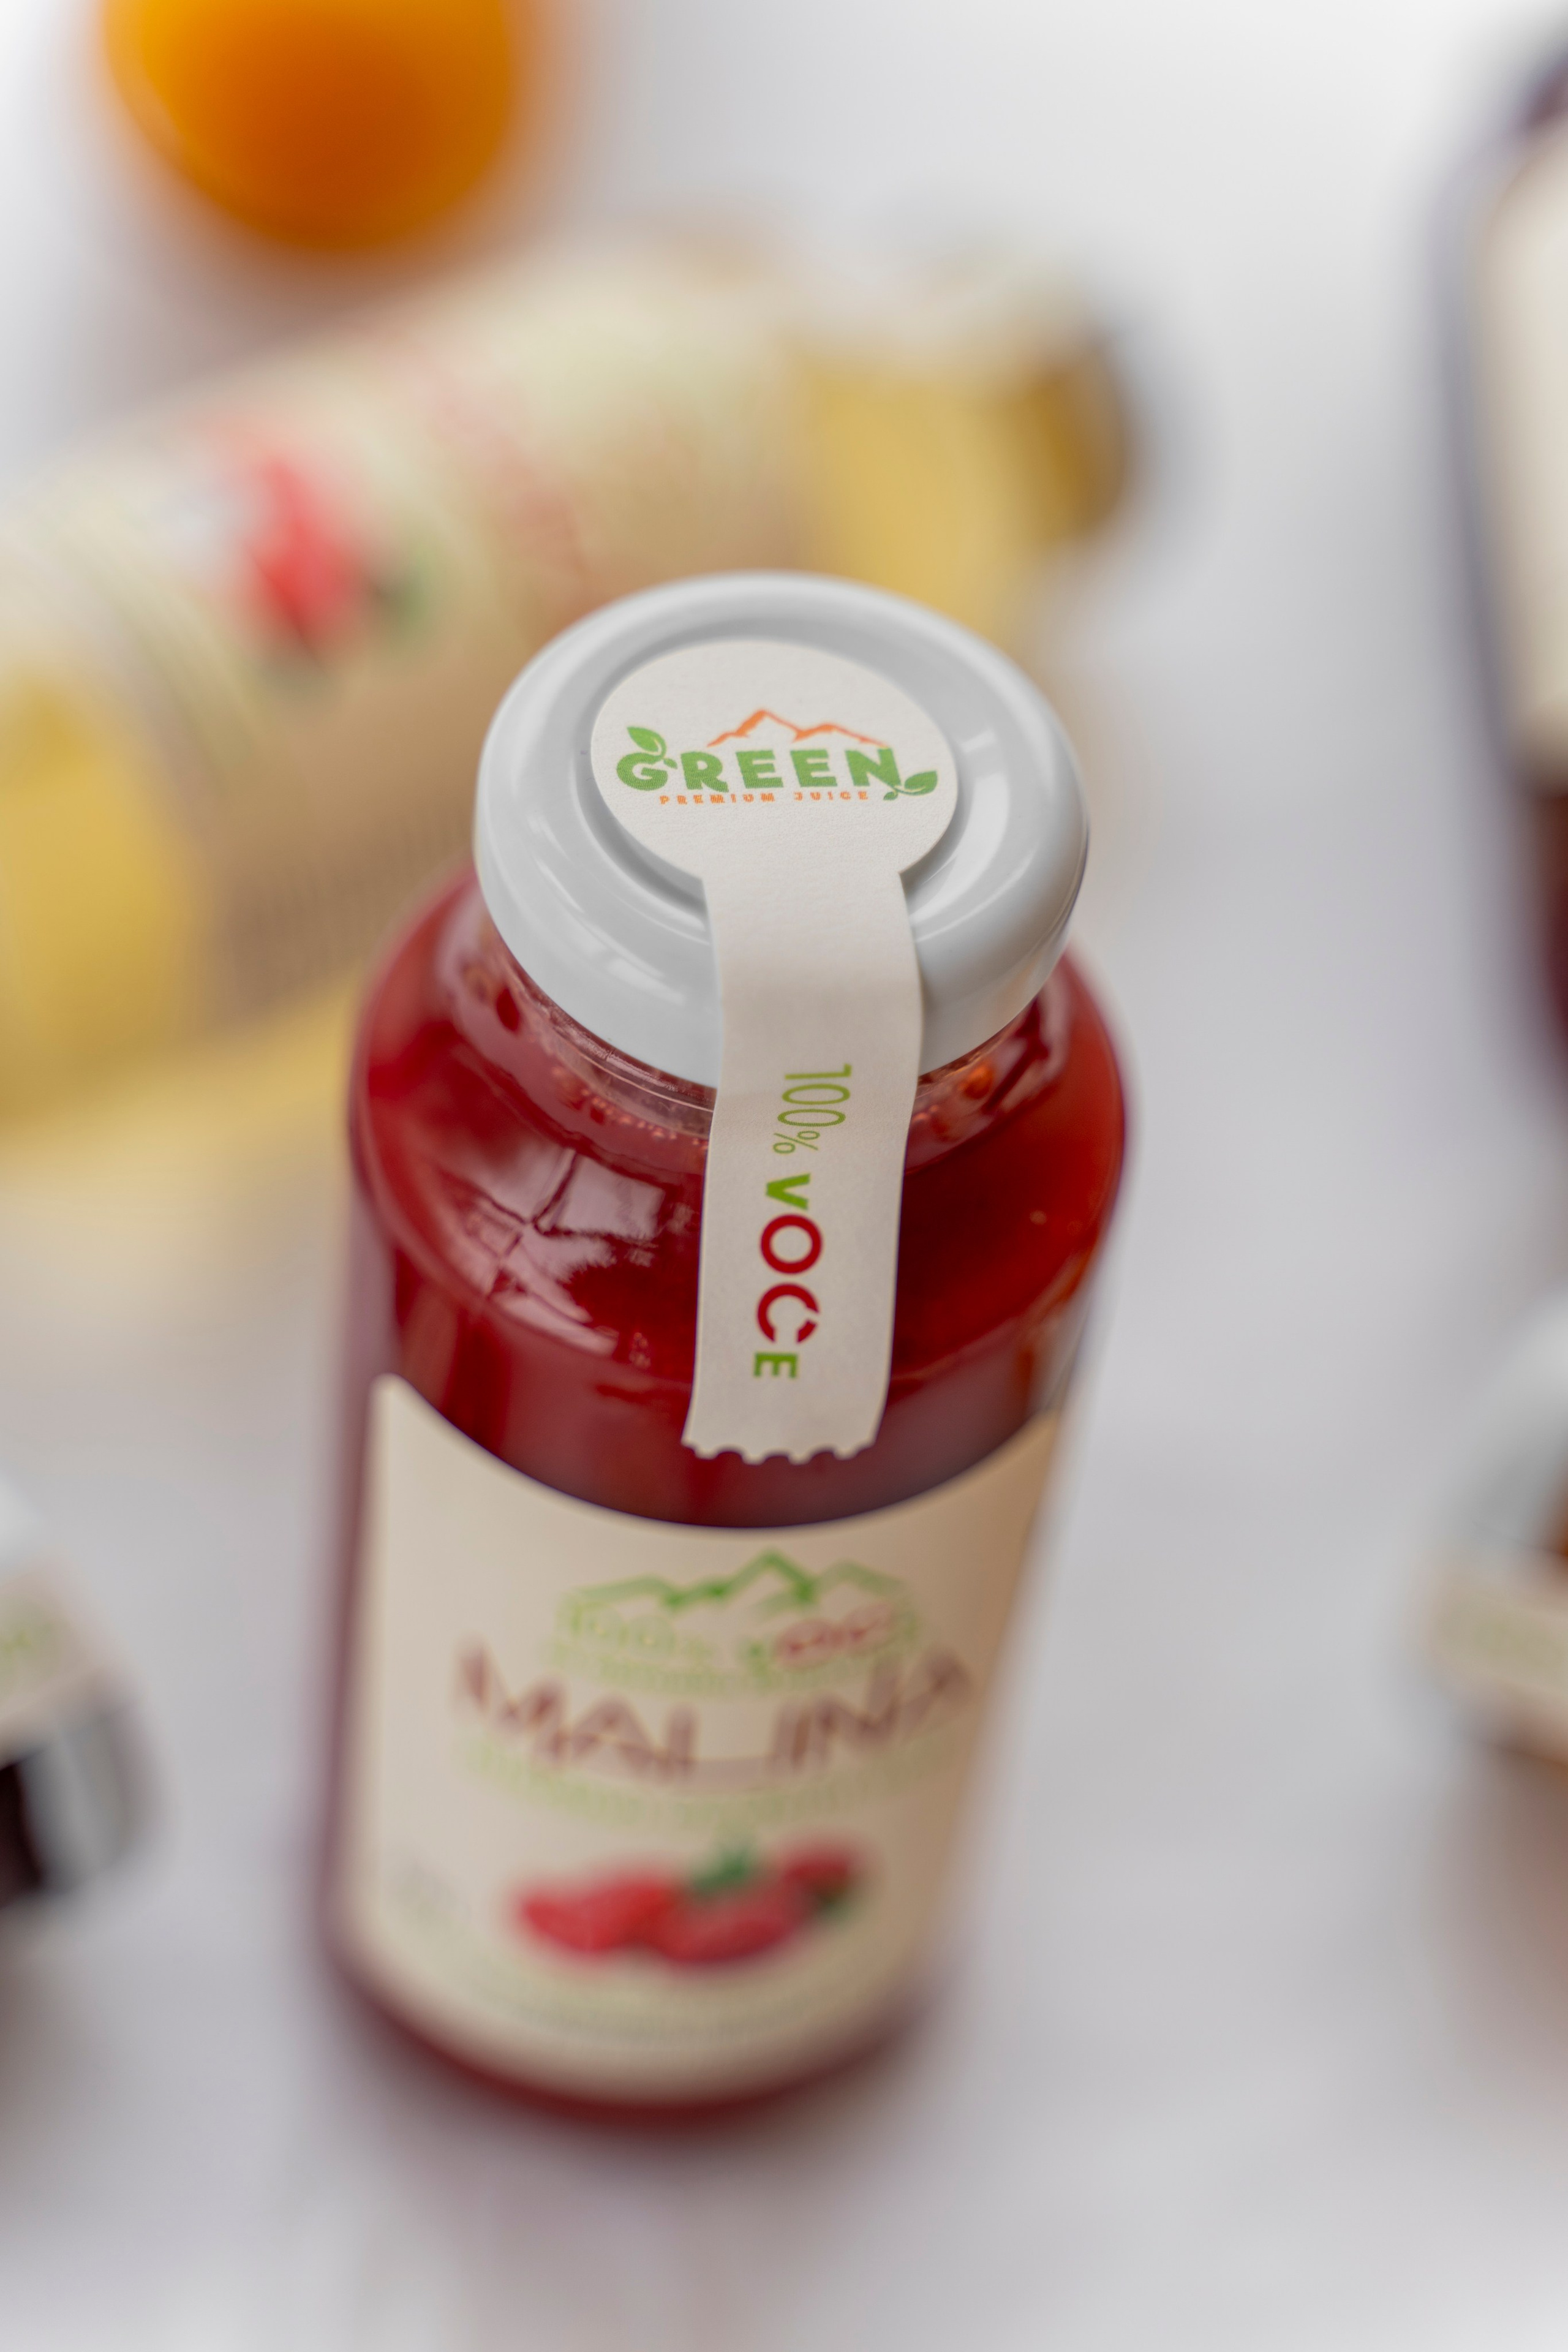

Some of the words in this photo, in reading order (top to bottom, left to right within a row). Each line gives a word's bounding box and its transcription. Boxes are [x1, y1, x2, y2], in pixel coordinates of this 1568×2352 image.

[616, 746, 903, 794] GREEN
[658, 793, 776, 805] PREMIUM
[772, 1063, 853, 1156] 100%
